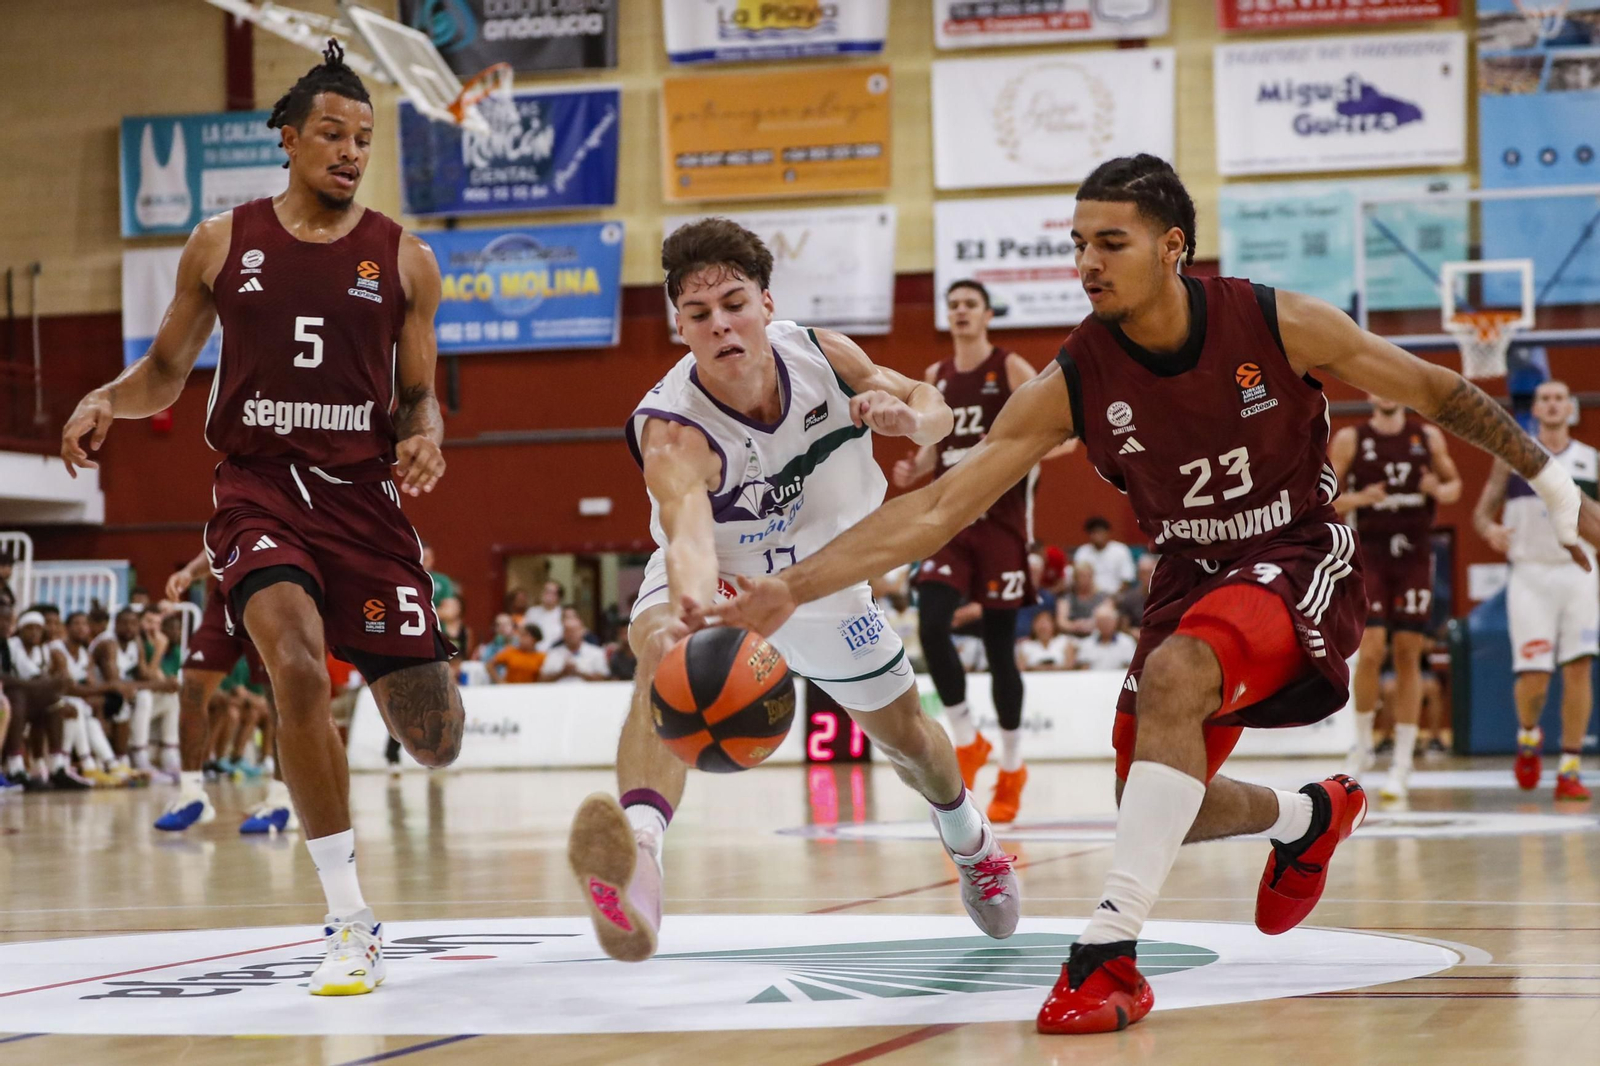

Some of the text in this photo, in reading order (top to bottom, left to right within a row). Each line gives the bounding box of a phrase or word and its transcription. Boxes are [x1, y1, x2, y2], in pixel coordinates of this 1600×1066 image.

[956, 235, 1073, 261] El Peño
[441, 266, 601, 302] ACO MOLINA
[294, 316, 325, 369] 5
[242, 390, 375, 436] siegmund
[953, 405, 985, 436] 22
[1240, 398, 1279, 419] oneteam
[1179, 446, 1254, 508] 23
[396, 586, 426, 636] 5
[1405, 587, 1432, 615] 17
[807, 711, 865, 762] 21
